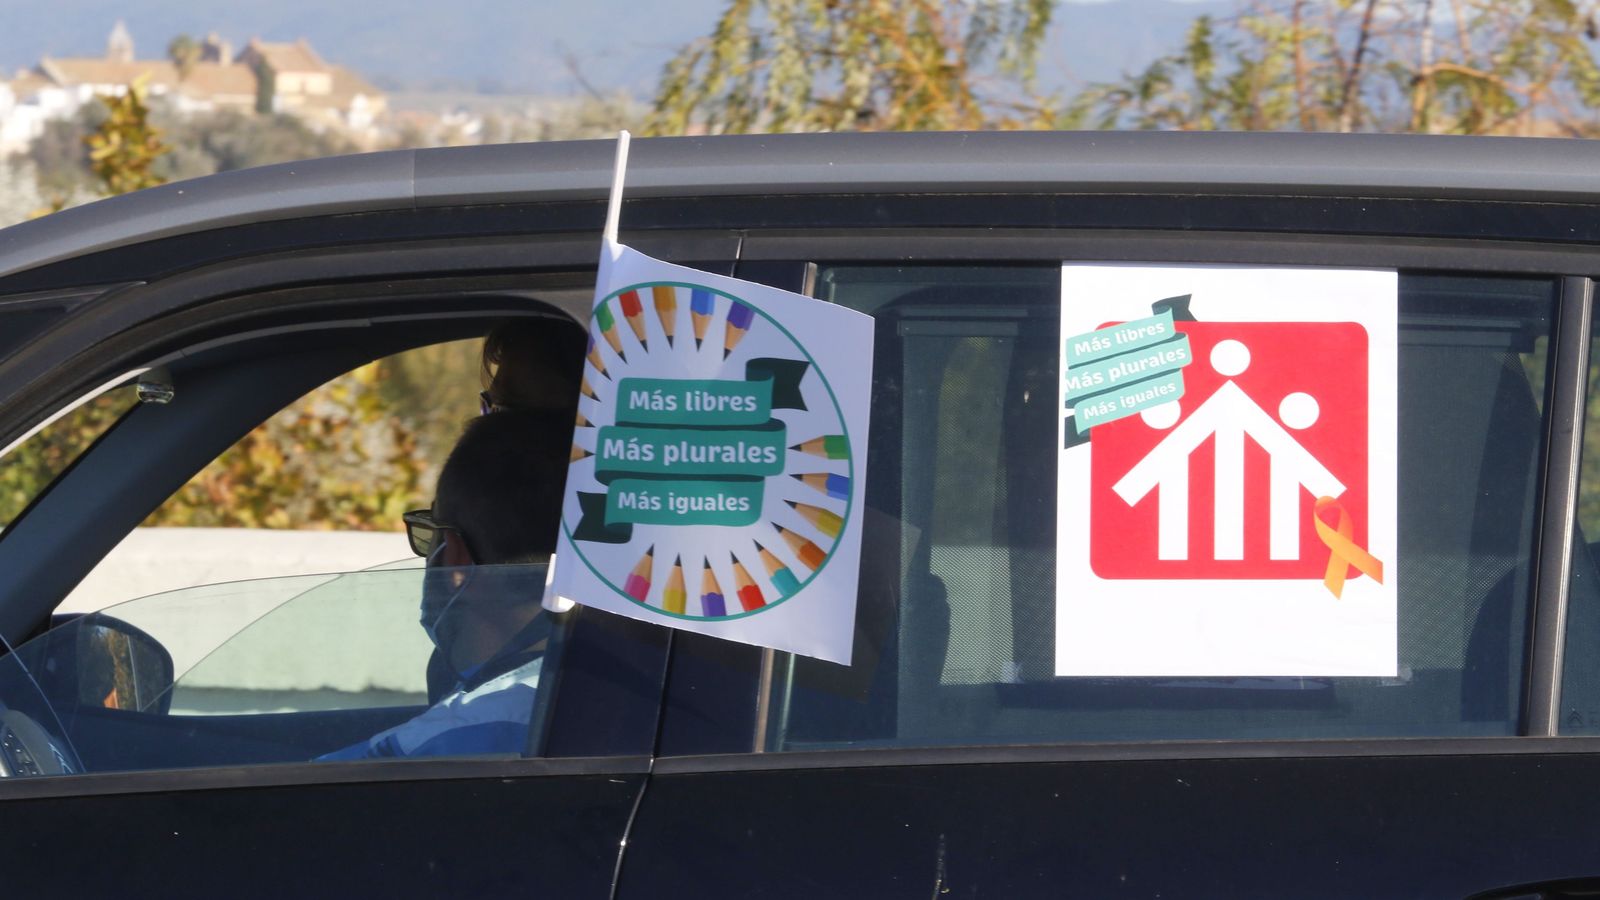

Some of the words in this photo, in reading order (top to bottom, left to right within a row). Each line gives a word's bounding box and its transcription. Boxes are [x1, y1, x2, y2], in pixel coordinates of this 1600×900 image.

[1074, 336, 1112, 356] Más
[1114, 322, 1165, 344] libres
[1065, 371, 1105, 393] Más
[1108, 348, 1186, 382] plurales
[629, 389, 678, 411] Más
[685, 390, 757, 412] libres
[1083, 401, 1117, 420] Más
[1120, 382, 1176, 408] iguales
[603, 437, 655, 461] Más
[663, 441, 777, 466] plurales
[617, 491, 661, 511] Más
[668, 492, 750, 515] iguales
